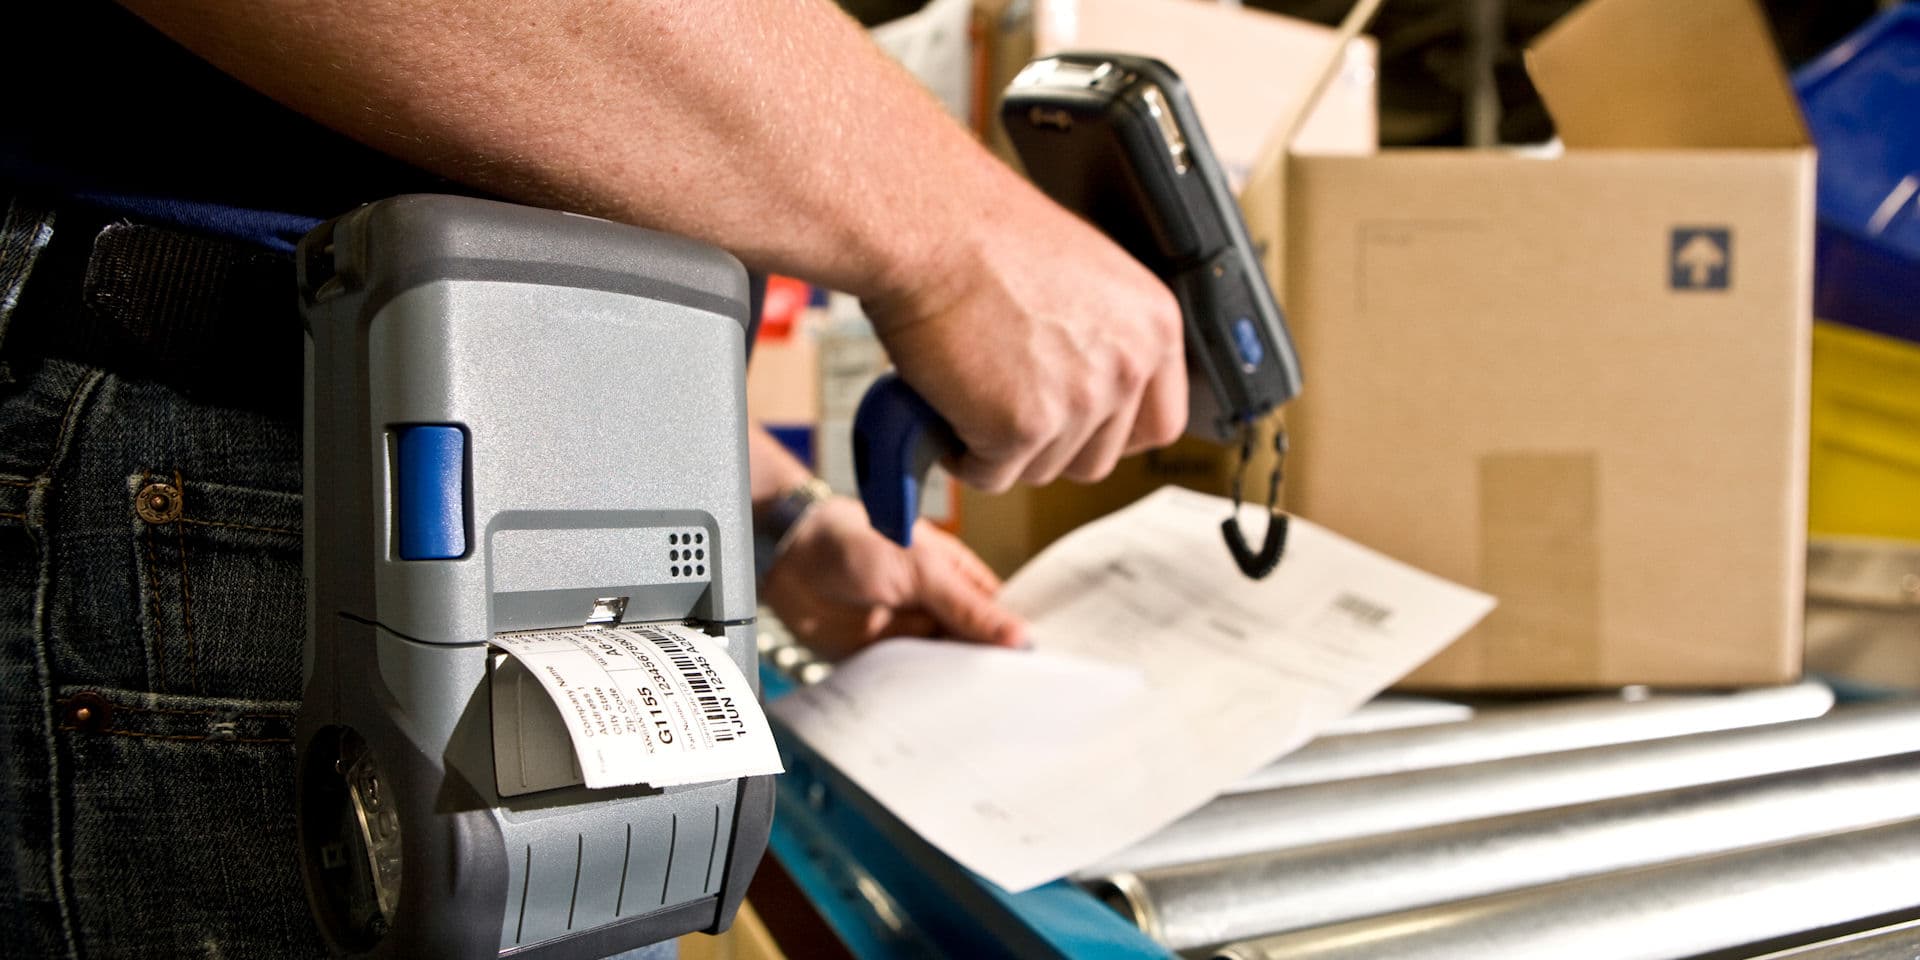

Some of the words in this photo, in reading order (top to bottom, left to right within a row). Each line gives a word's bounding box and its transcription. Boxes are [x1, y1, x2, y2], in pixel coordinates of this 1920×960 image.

[546, 665, 567, 687] Name
[695, 656, 725, 692] 12345
[565, 689, 594, 737] Company
[594, 686, 612, 711] State
[609, 688, 627, 713] Code
[583, 693, 608, 735] Address
[610, 714, 623, 735] City
[625, 716, 637, 733] Zip
[637, 687, 673, 744] G1155
[720, 697, 746, 736] 1JUN
